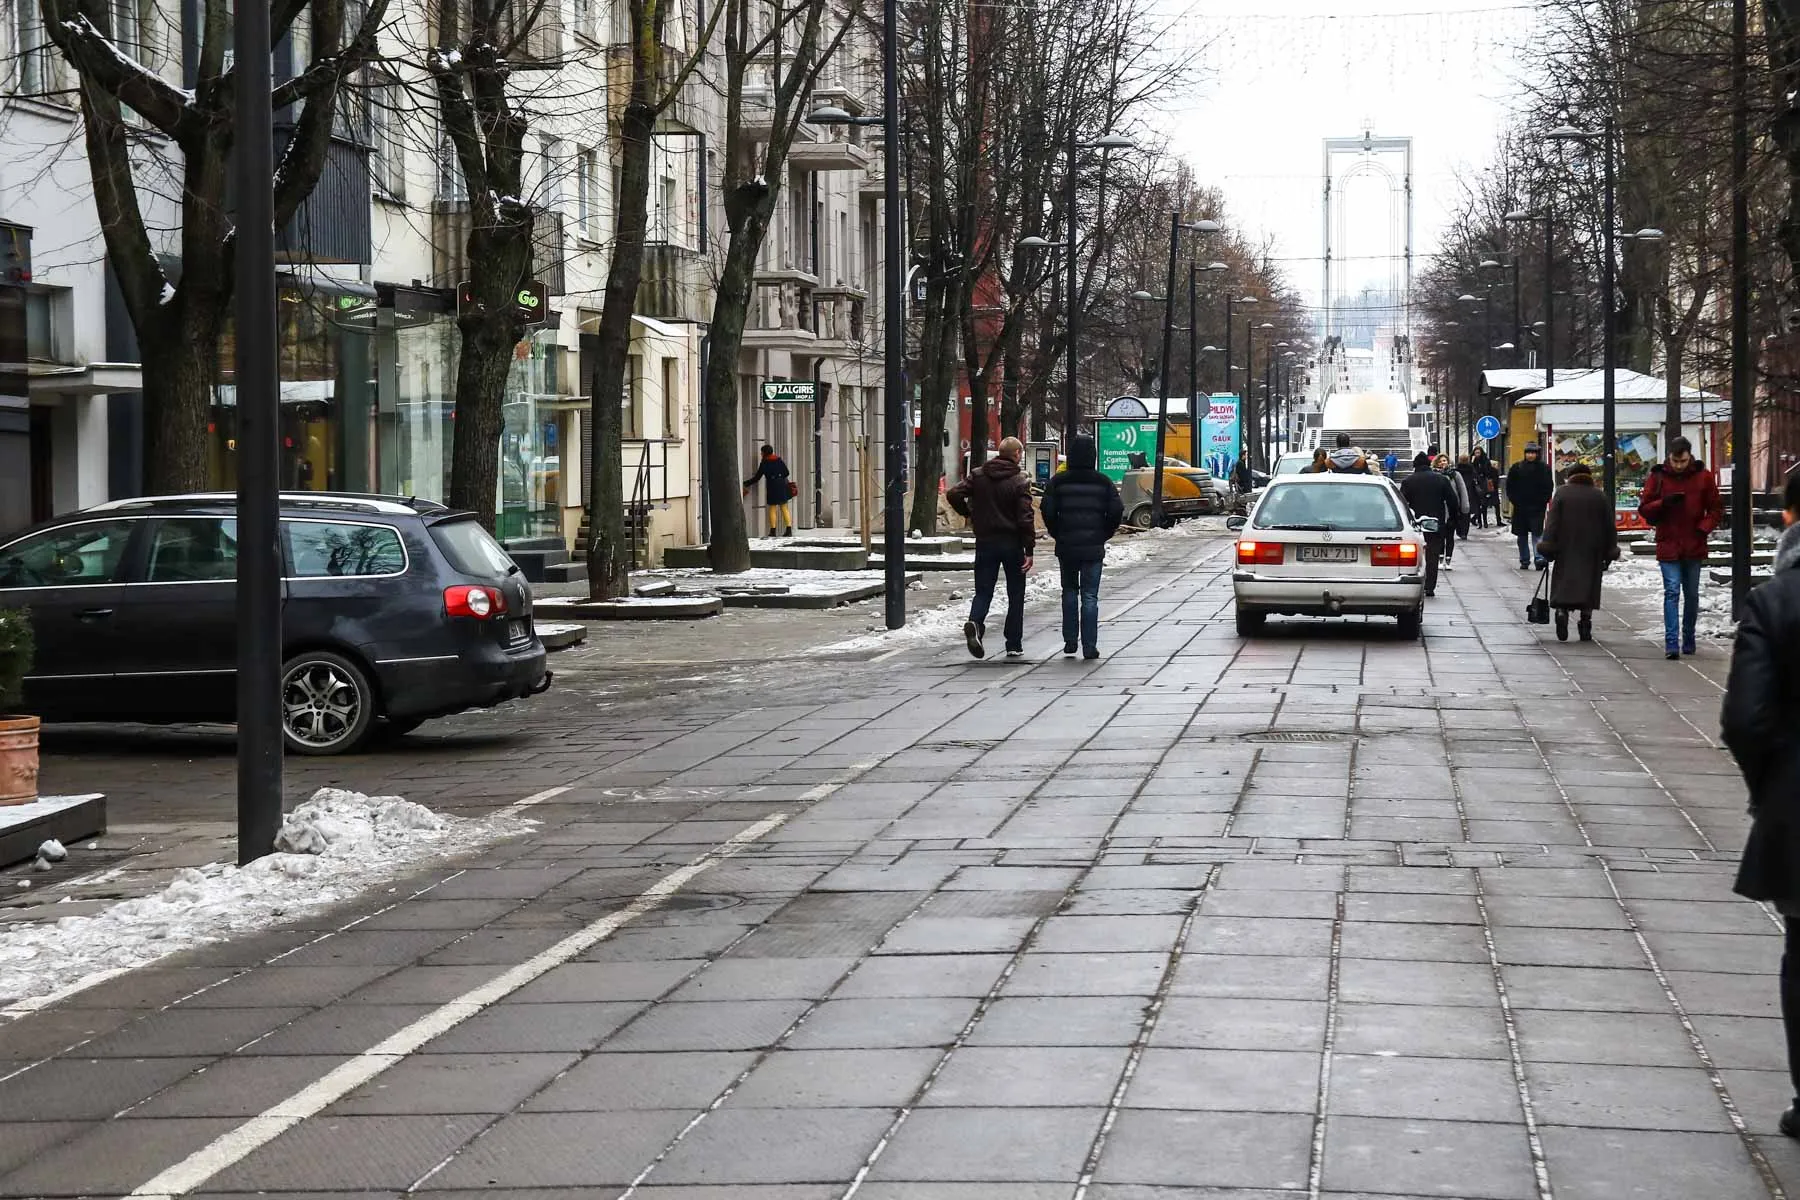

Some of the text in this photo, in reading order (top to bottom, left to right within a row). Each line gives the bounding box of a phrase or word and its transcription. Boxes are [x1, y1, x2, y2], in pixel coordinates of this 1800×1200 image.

[518, 290, 539, 307] Go
[1209, 406, 1234, 414] PILDYK
[1304, 548, 1355, 559] FUN 711
